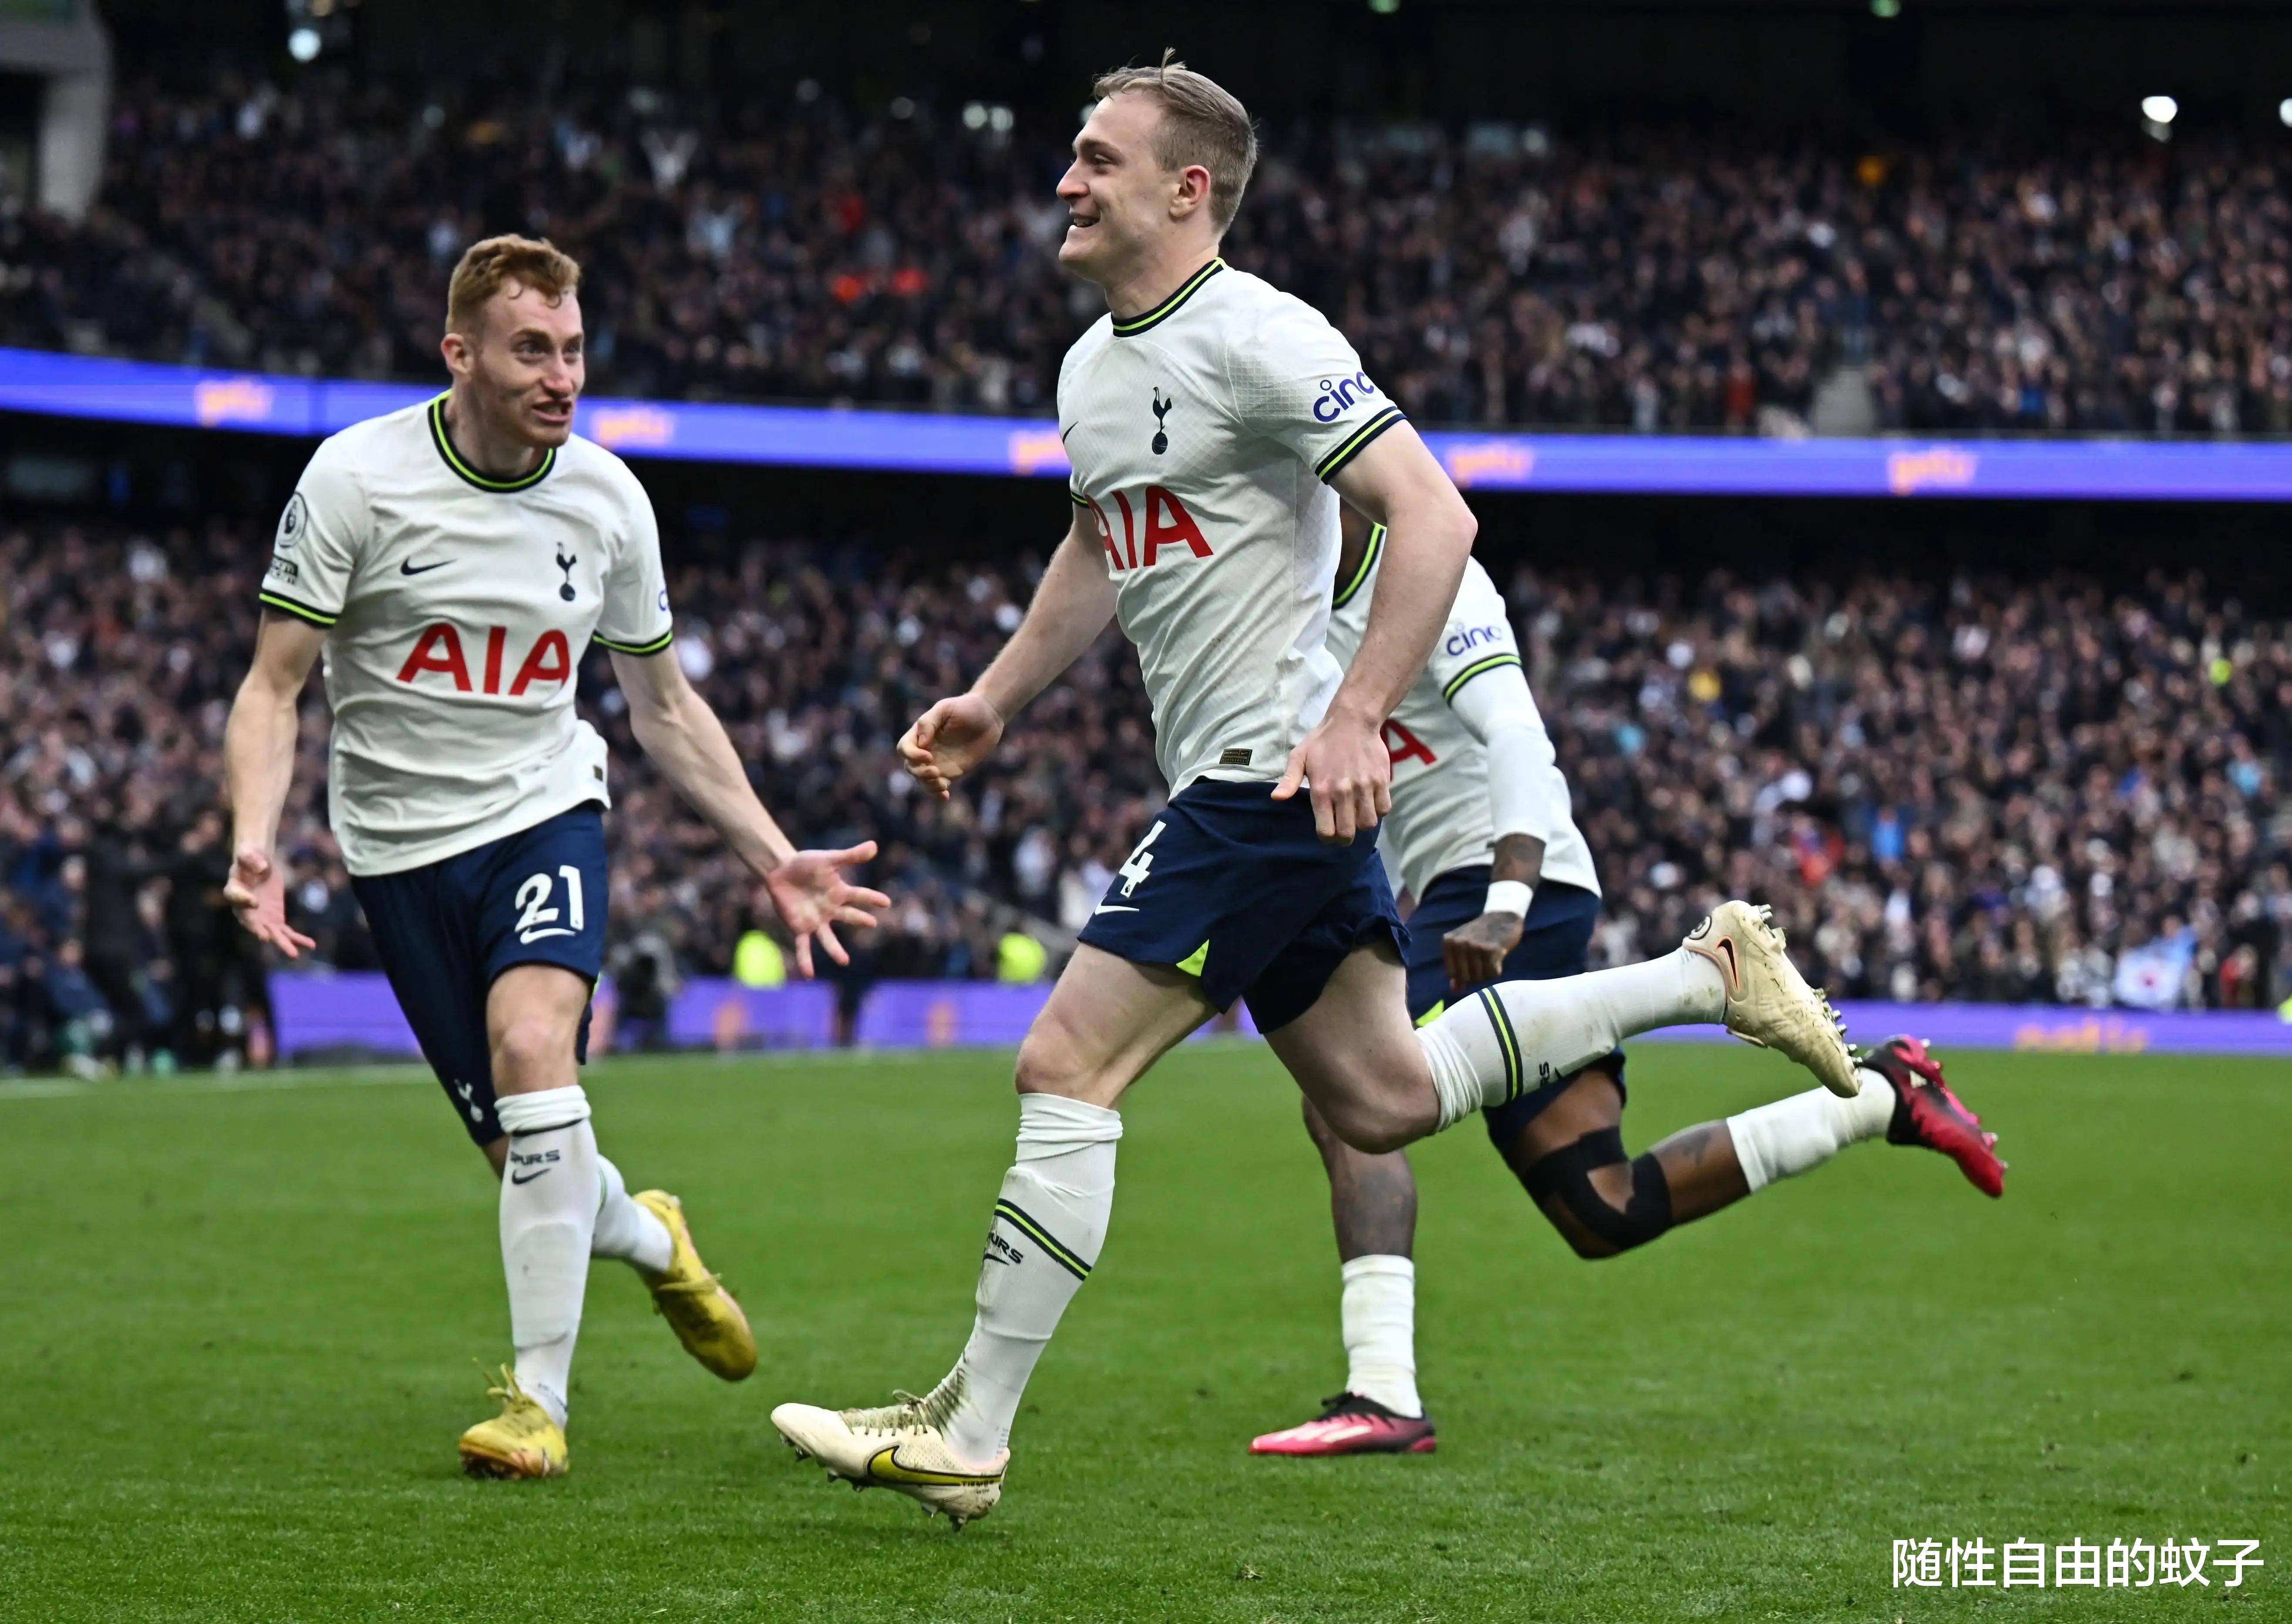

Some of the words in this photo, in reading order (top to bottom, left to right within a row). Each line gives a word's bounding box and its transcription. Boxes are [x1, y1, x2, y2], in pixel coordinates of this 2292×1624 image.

[1084, 485, 1214, 570] AIA
[396, 622, 570, 696] AIA
[1119, 819, 1167, 898] 4
[515, 865, 584, 932] 21
